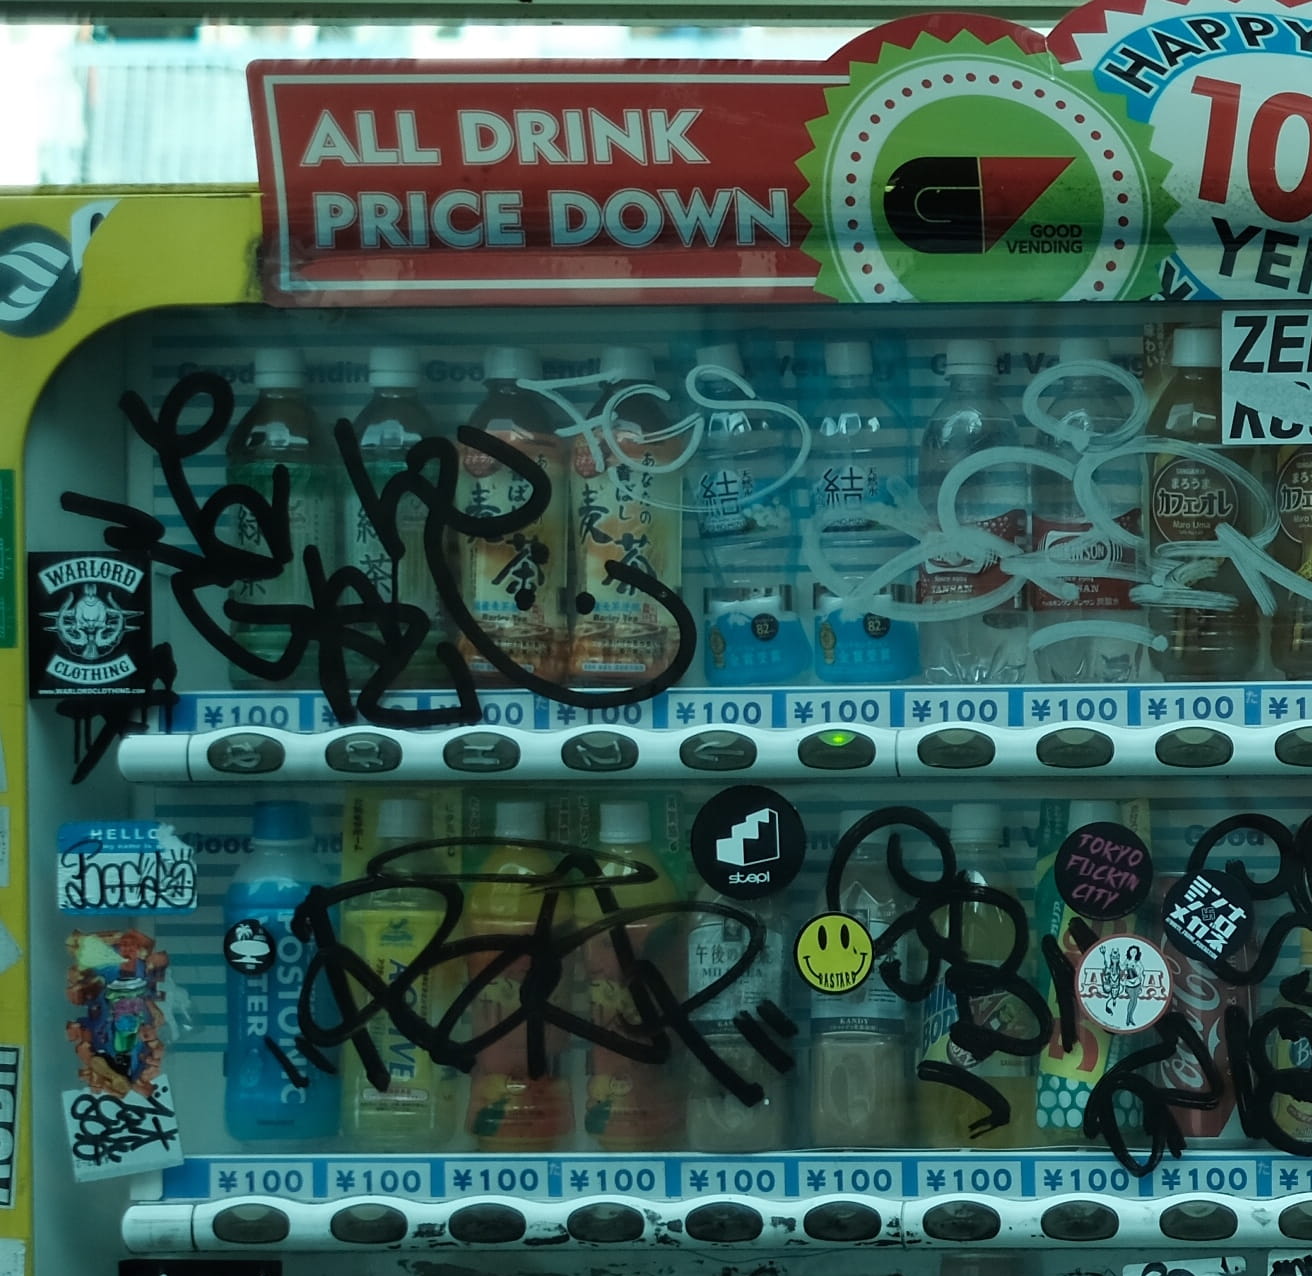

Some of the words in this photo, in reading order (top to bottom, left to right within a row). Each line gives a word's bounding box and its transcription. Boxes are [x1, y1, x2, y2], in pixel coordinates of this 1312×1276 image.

[301, 109, 441, 167] ALL
[458, 107, 710, 166] DRINK
[314, 190, 527, 250] PRICE
[548, 186, 790, 249] DOWN
[1030, 223, 1082, 237] GOOD
[1006, 240, 1083, 254] VENDING
[1158, 486, 1231, 517] カフェオレ
[45, 560, 137, 587] WARLORD
[55, 658, 130, 680] CLOTHING
[204, 705, 289, 727] ¥100
[794, 700, 879, 723] ¥100
[91, 828, 159, 840] HELLO
[1081, 834, 1143, 866] TOKYO
[1067, 854, 1140, 891] FUCKIN
[1072, 884, 1120, 909] CITY
[219, 1170, 303, 1193] ¥100
[807, 1169, 892, 1192] ¥100
[1161, 1167, 1247, 1196] ¥100
